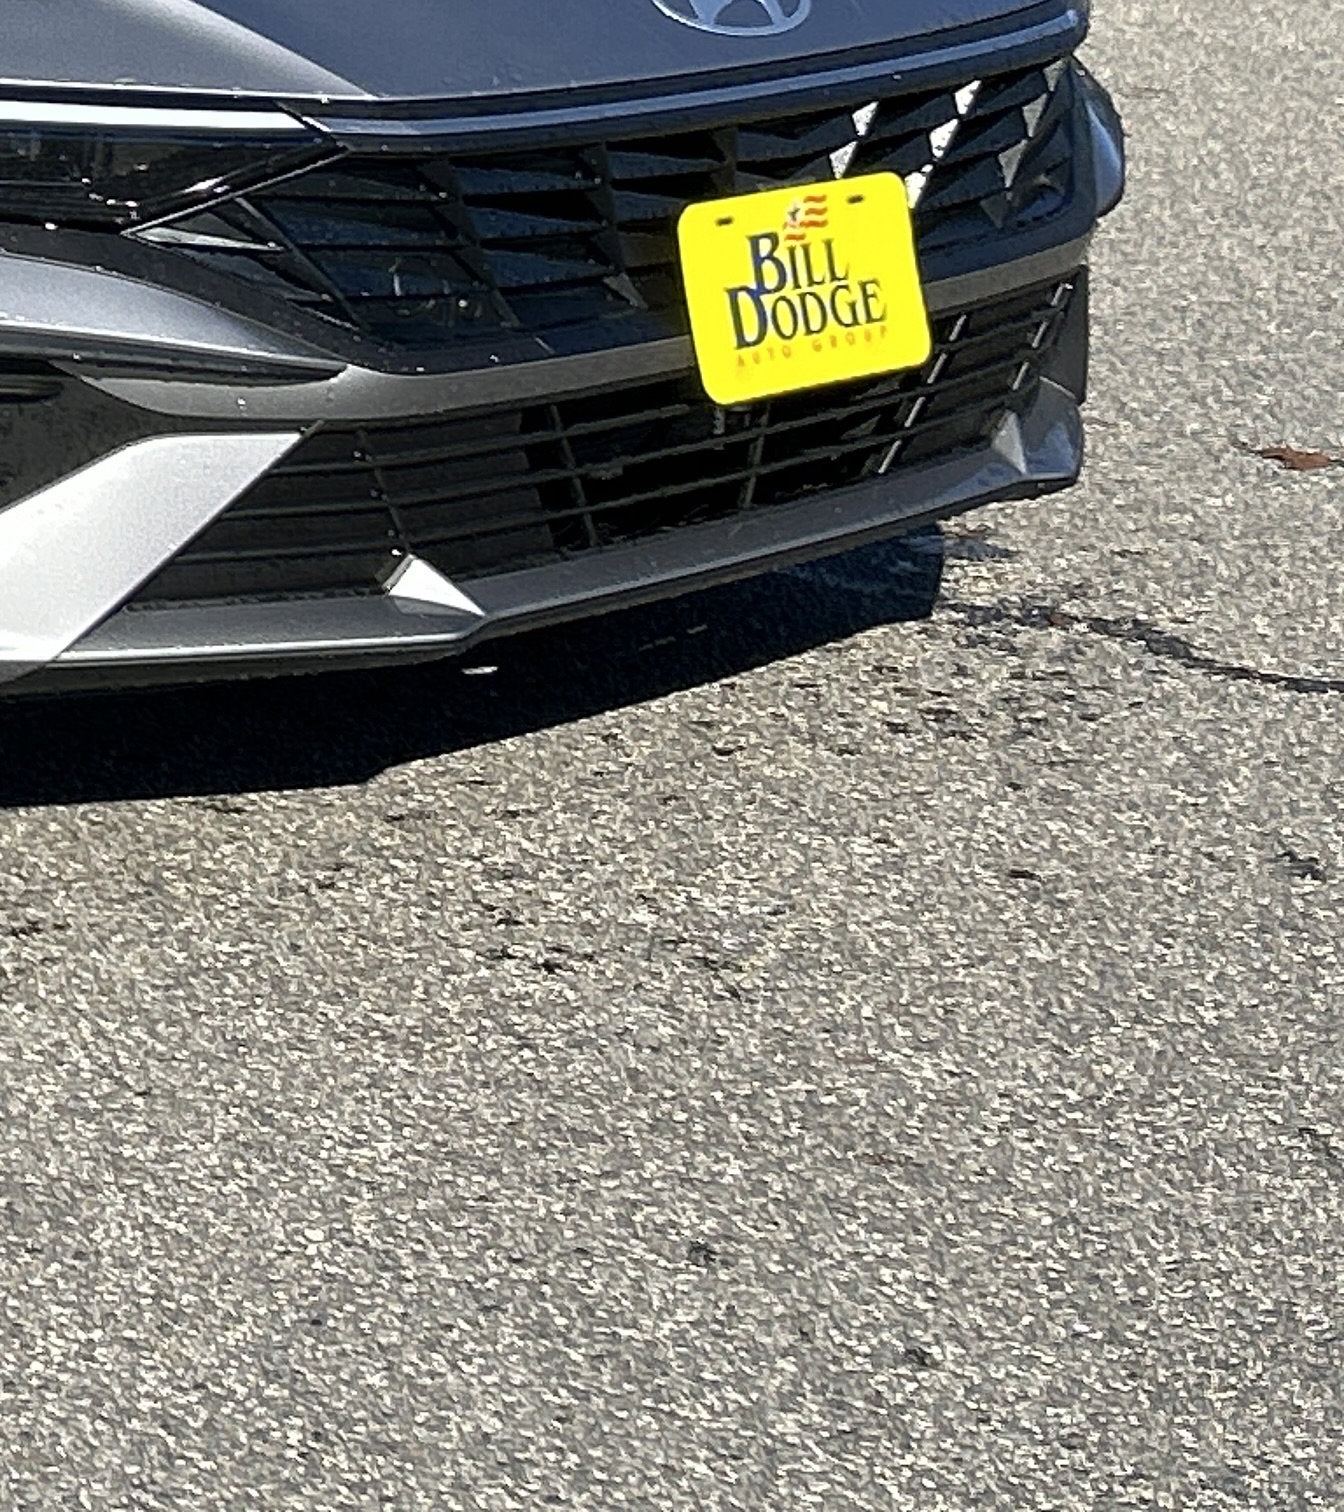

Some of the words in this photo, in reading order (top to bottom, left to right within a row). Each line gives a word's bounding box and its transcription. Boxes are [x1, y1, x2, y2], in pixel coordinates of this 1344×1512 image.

[746, 232, 850, 297] BILL
[723, 278, 888, 350] DODGE
[737, 345, 792, 367] AUTO
[811, 325, 887, 352] GROUP
